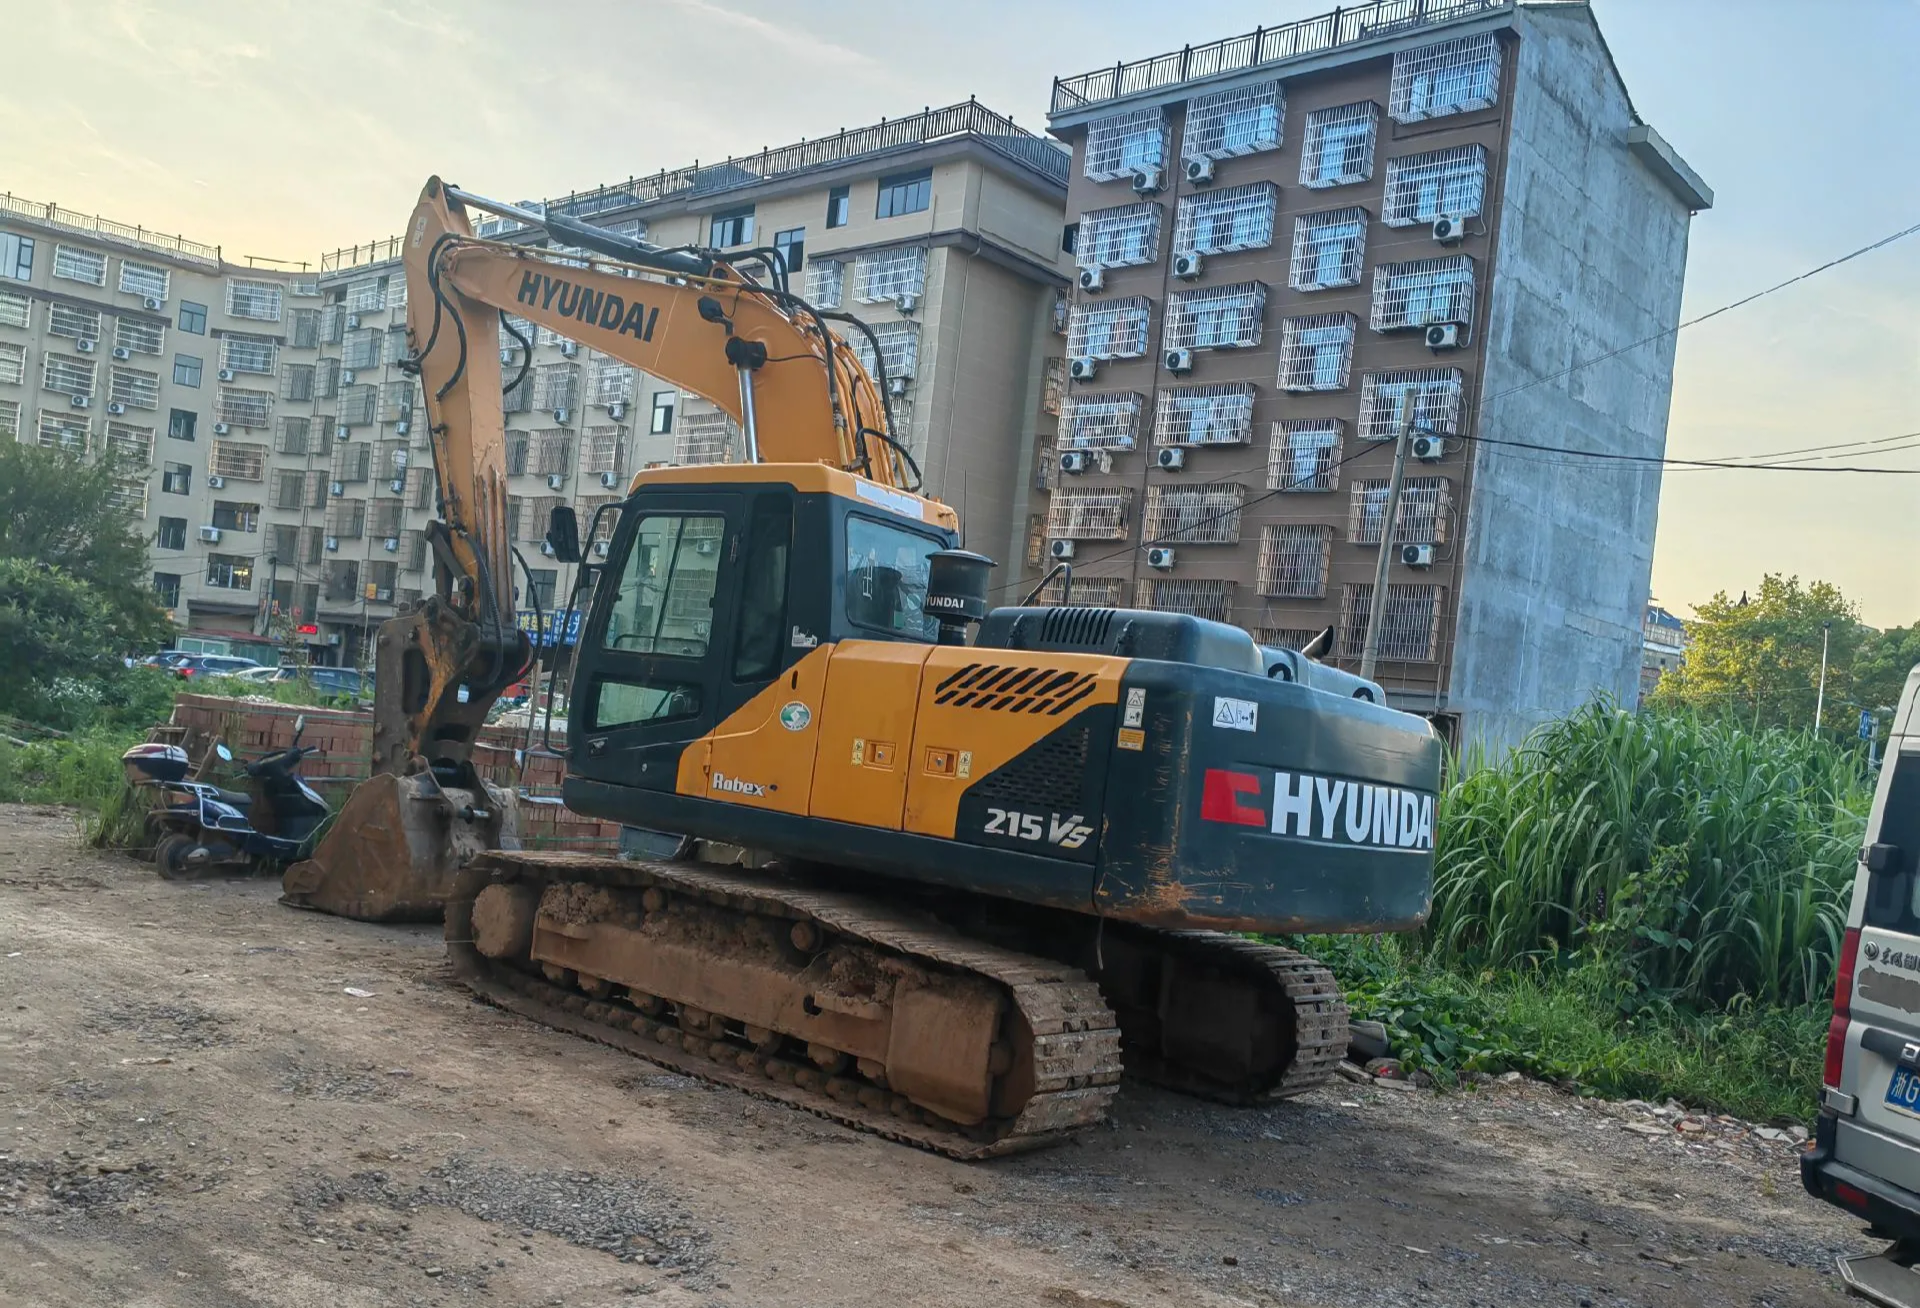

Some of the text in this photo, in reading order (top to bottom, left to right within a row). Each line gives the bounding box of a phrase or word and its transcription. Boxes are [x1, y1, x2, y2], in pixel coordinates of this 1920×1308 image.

[517, 270, 660, 343] HYUNDAI
[926, 595, 965, 609] YUNDAI
[712, 772, 766, 797] Robex
[984, 808, 1044, 840] 215
